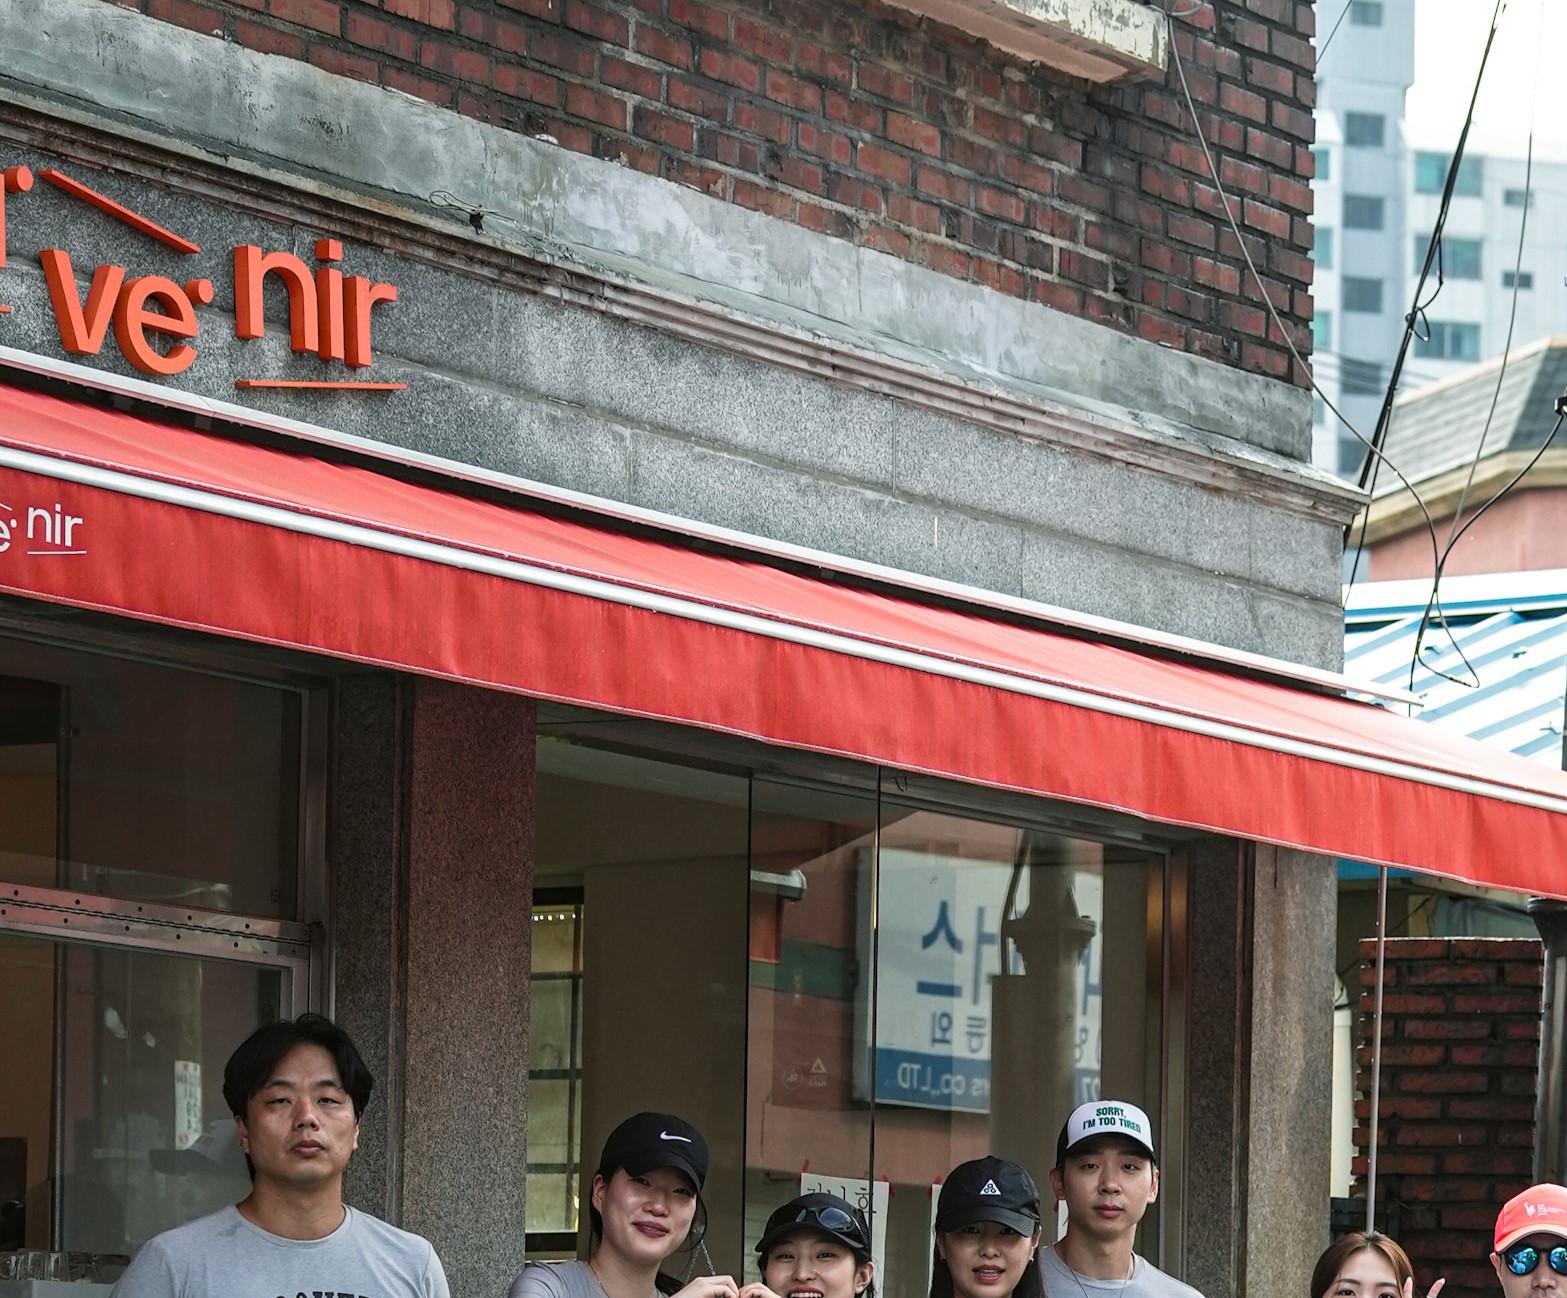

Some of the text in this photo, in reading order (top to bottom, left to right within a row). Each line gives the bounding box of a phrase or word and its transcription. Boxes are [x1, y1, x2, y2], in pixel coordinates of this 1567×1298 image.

[1083, 1117, 1142, 1134] I'M TOO TIRED
